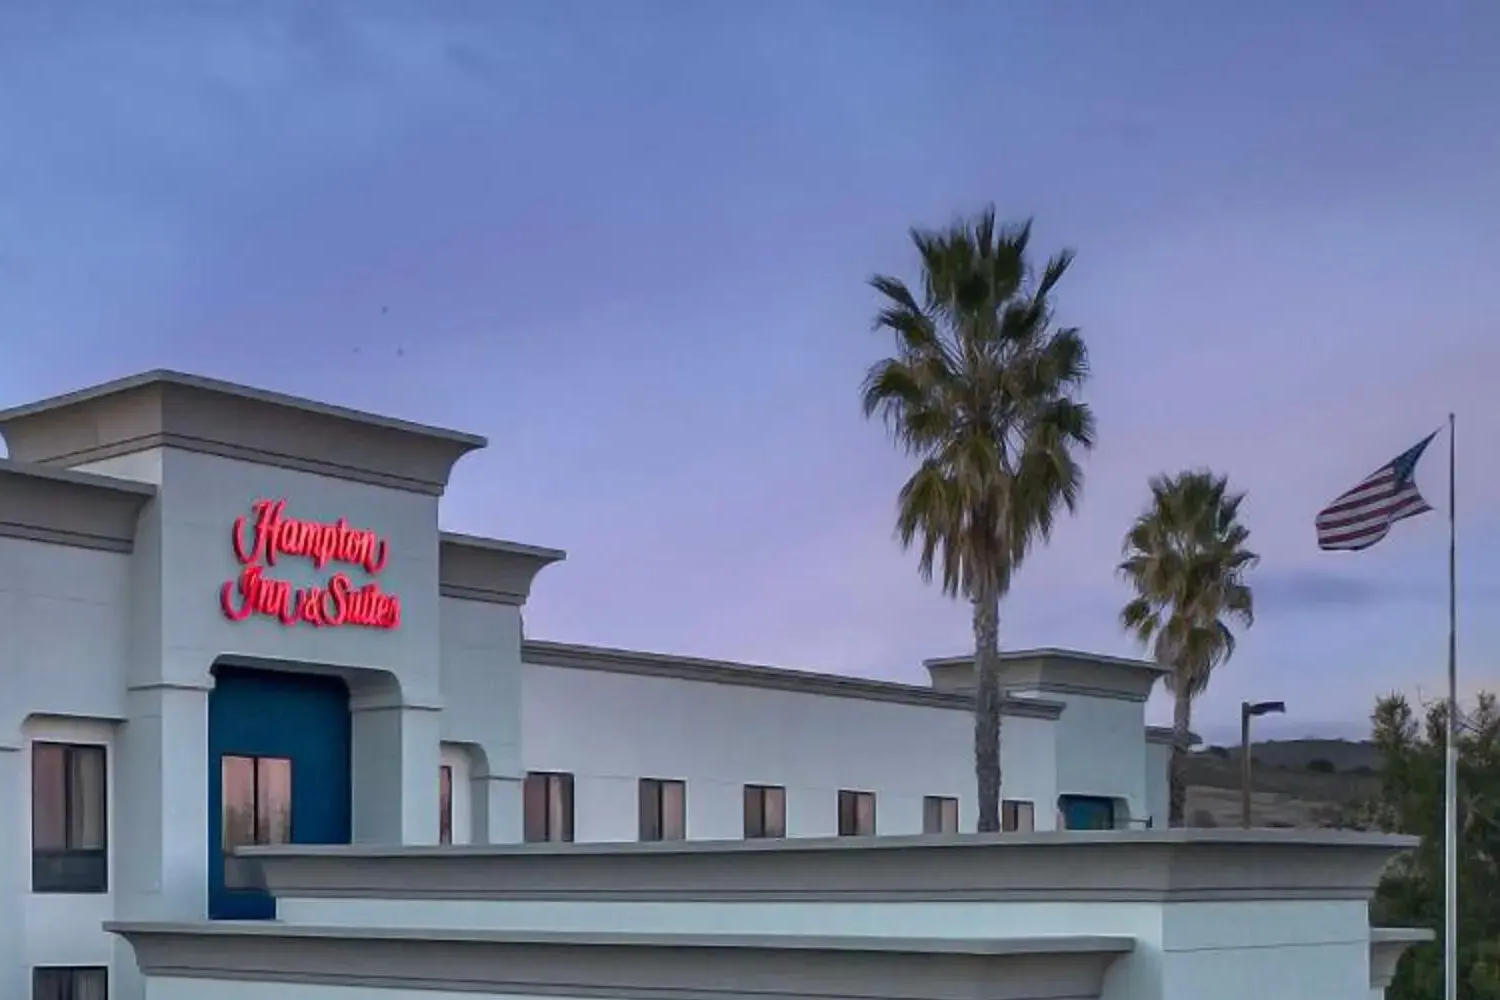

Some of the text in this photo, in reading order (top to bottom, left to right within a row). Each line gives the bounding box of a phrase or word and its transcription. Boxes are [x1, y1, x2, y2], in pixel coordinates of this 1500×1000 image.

[233, 499, 388, 574] Hampton
[221, 565, 401, 629] Inn & Suites
